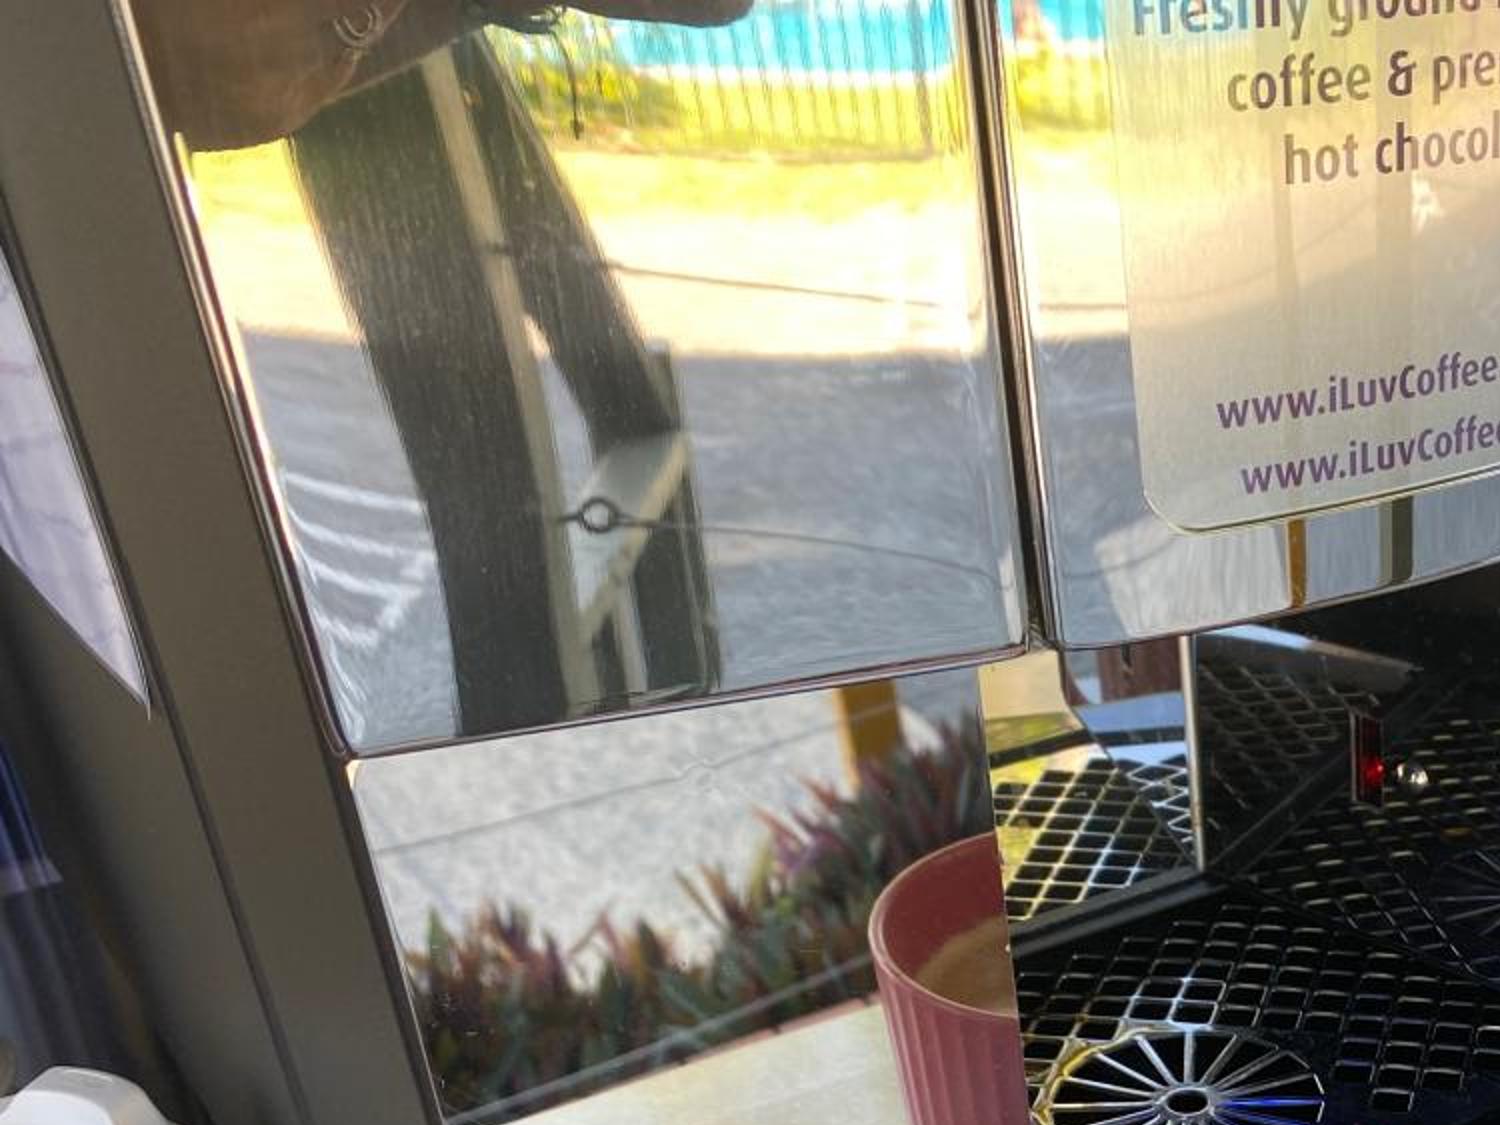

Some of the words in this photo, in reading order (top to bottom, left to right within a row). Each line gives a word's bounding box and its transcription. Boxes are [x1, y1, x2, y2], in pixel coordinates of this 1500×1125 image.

[1227, 52, 1371, 111] coffee
[1387, 50, 1417, 97] &
[1283, 133, 1359, 184] hot
